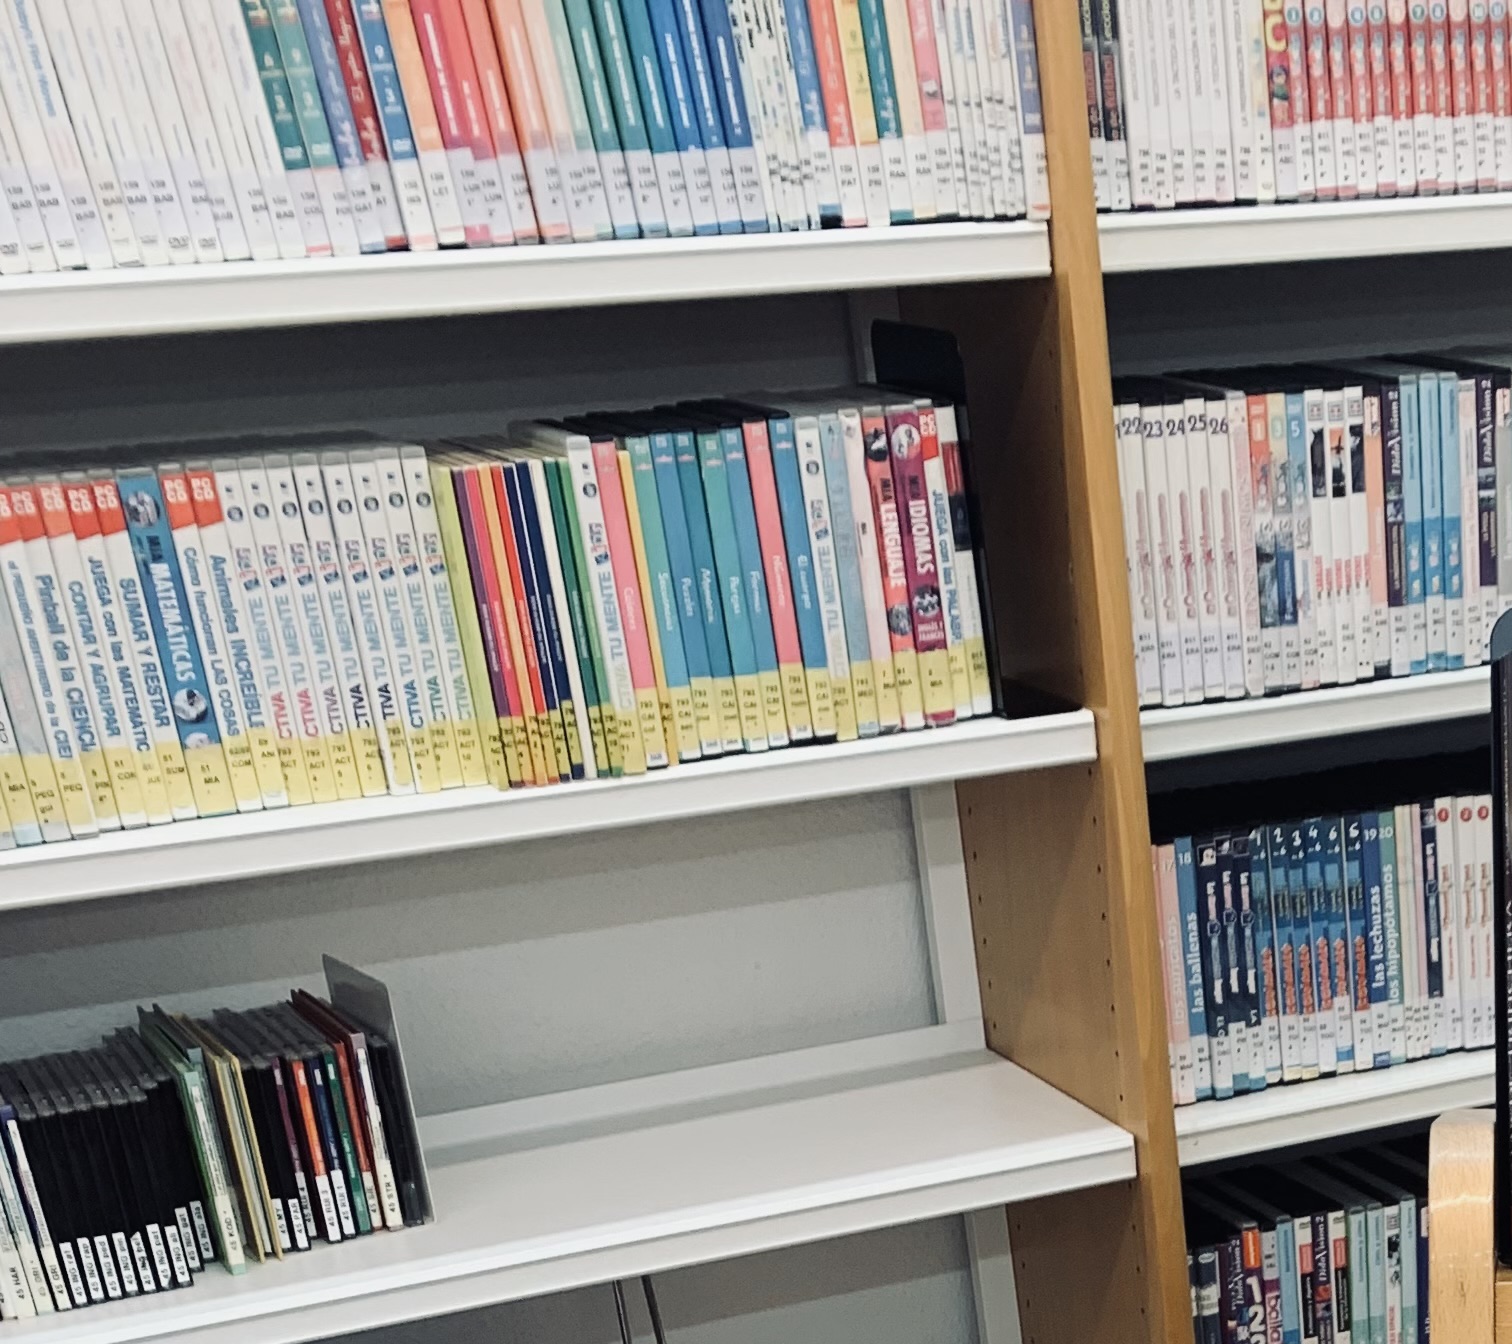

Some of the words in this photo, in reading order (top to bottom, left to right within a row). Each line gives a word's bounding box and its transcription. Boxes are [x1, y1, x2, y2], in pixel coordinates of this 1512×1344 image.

[1123, 416, 1142, 433] 22
[1143, 420, 1163, 438] 23
[1166, 419, 1185, 436] 24
[1188, 413, 1207, 432] 25
[1209, 417, 1229, 434] 26
[908, 500, 935, 576] IDIOMAS
[119, 577, 149, 642] SUMAR
[150, 562, 197, 683] MATEMÁTICAS
[137, 646, 153, 658] Y
[89, 663, 121, 737] AGRUPAR
[140, 662, 170, 728] RESTAR
[1370, 884, 1384, 964] lechuzas
[1186, 911, 1204, 985] ballenas
[1371, 968, 1385, 989] las
[1191, 988, 1204, 1013] las
[1248, 1304, 1264, 1333] 2
